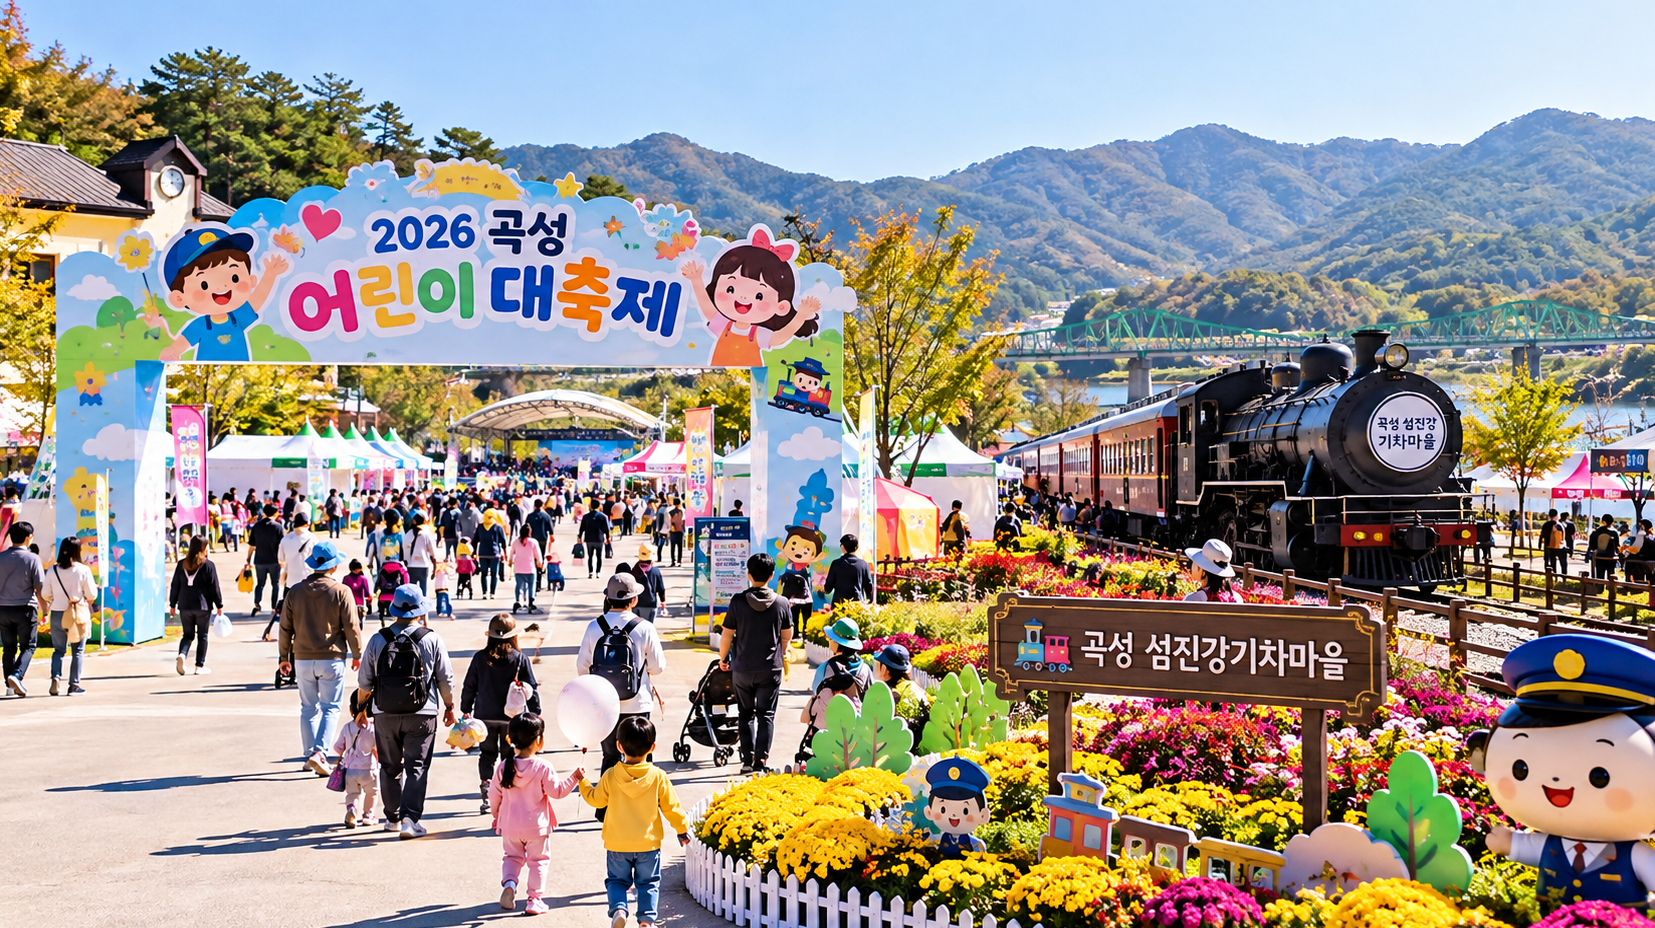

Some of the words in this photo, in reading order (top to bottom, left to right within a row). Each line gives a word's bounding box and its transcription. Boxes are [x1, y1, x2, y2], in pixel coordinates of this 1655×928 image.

[370, 213, 476, 254] 2026
[488, 209, 568, 257] 곡성
[288, 261, 475, 334] 어린이
[489, 256, 682, 338] 대축제
[1377, 417, 1398, 430] 곡성
[1402, 417, 1437, 430] 섬진강
[1378, 433, 1436, 450] 기차마을
[1080, 630, 1134, 669] 곡성
[1144, 633, 1348, 682] 섬진강기차마을
